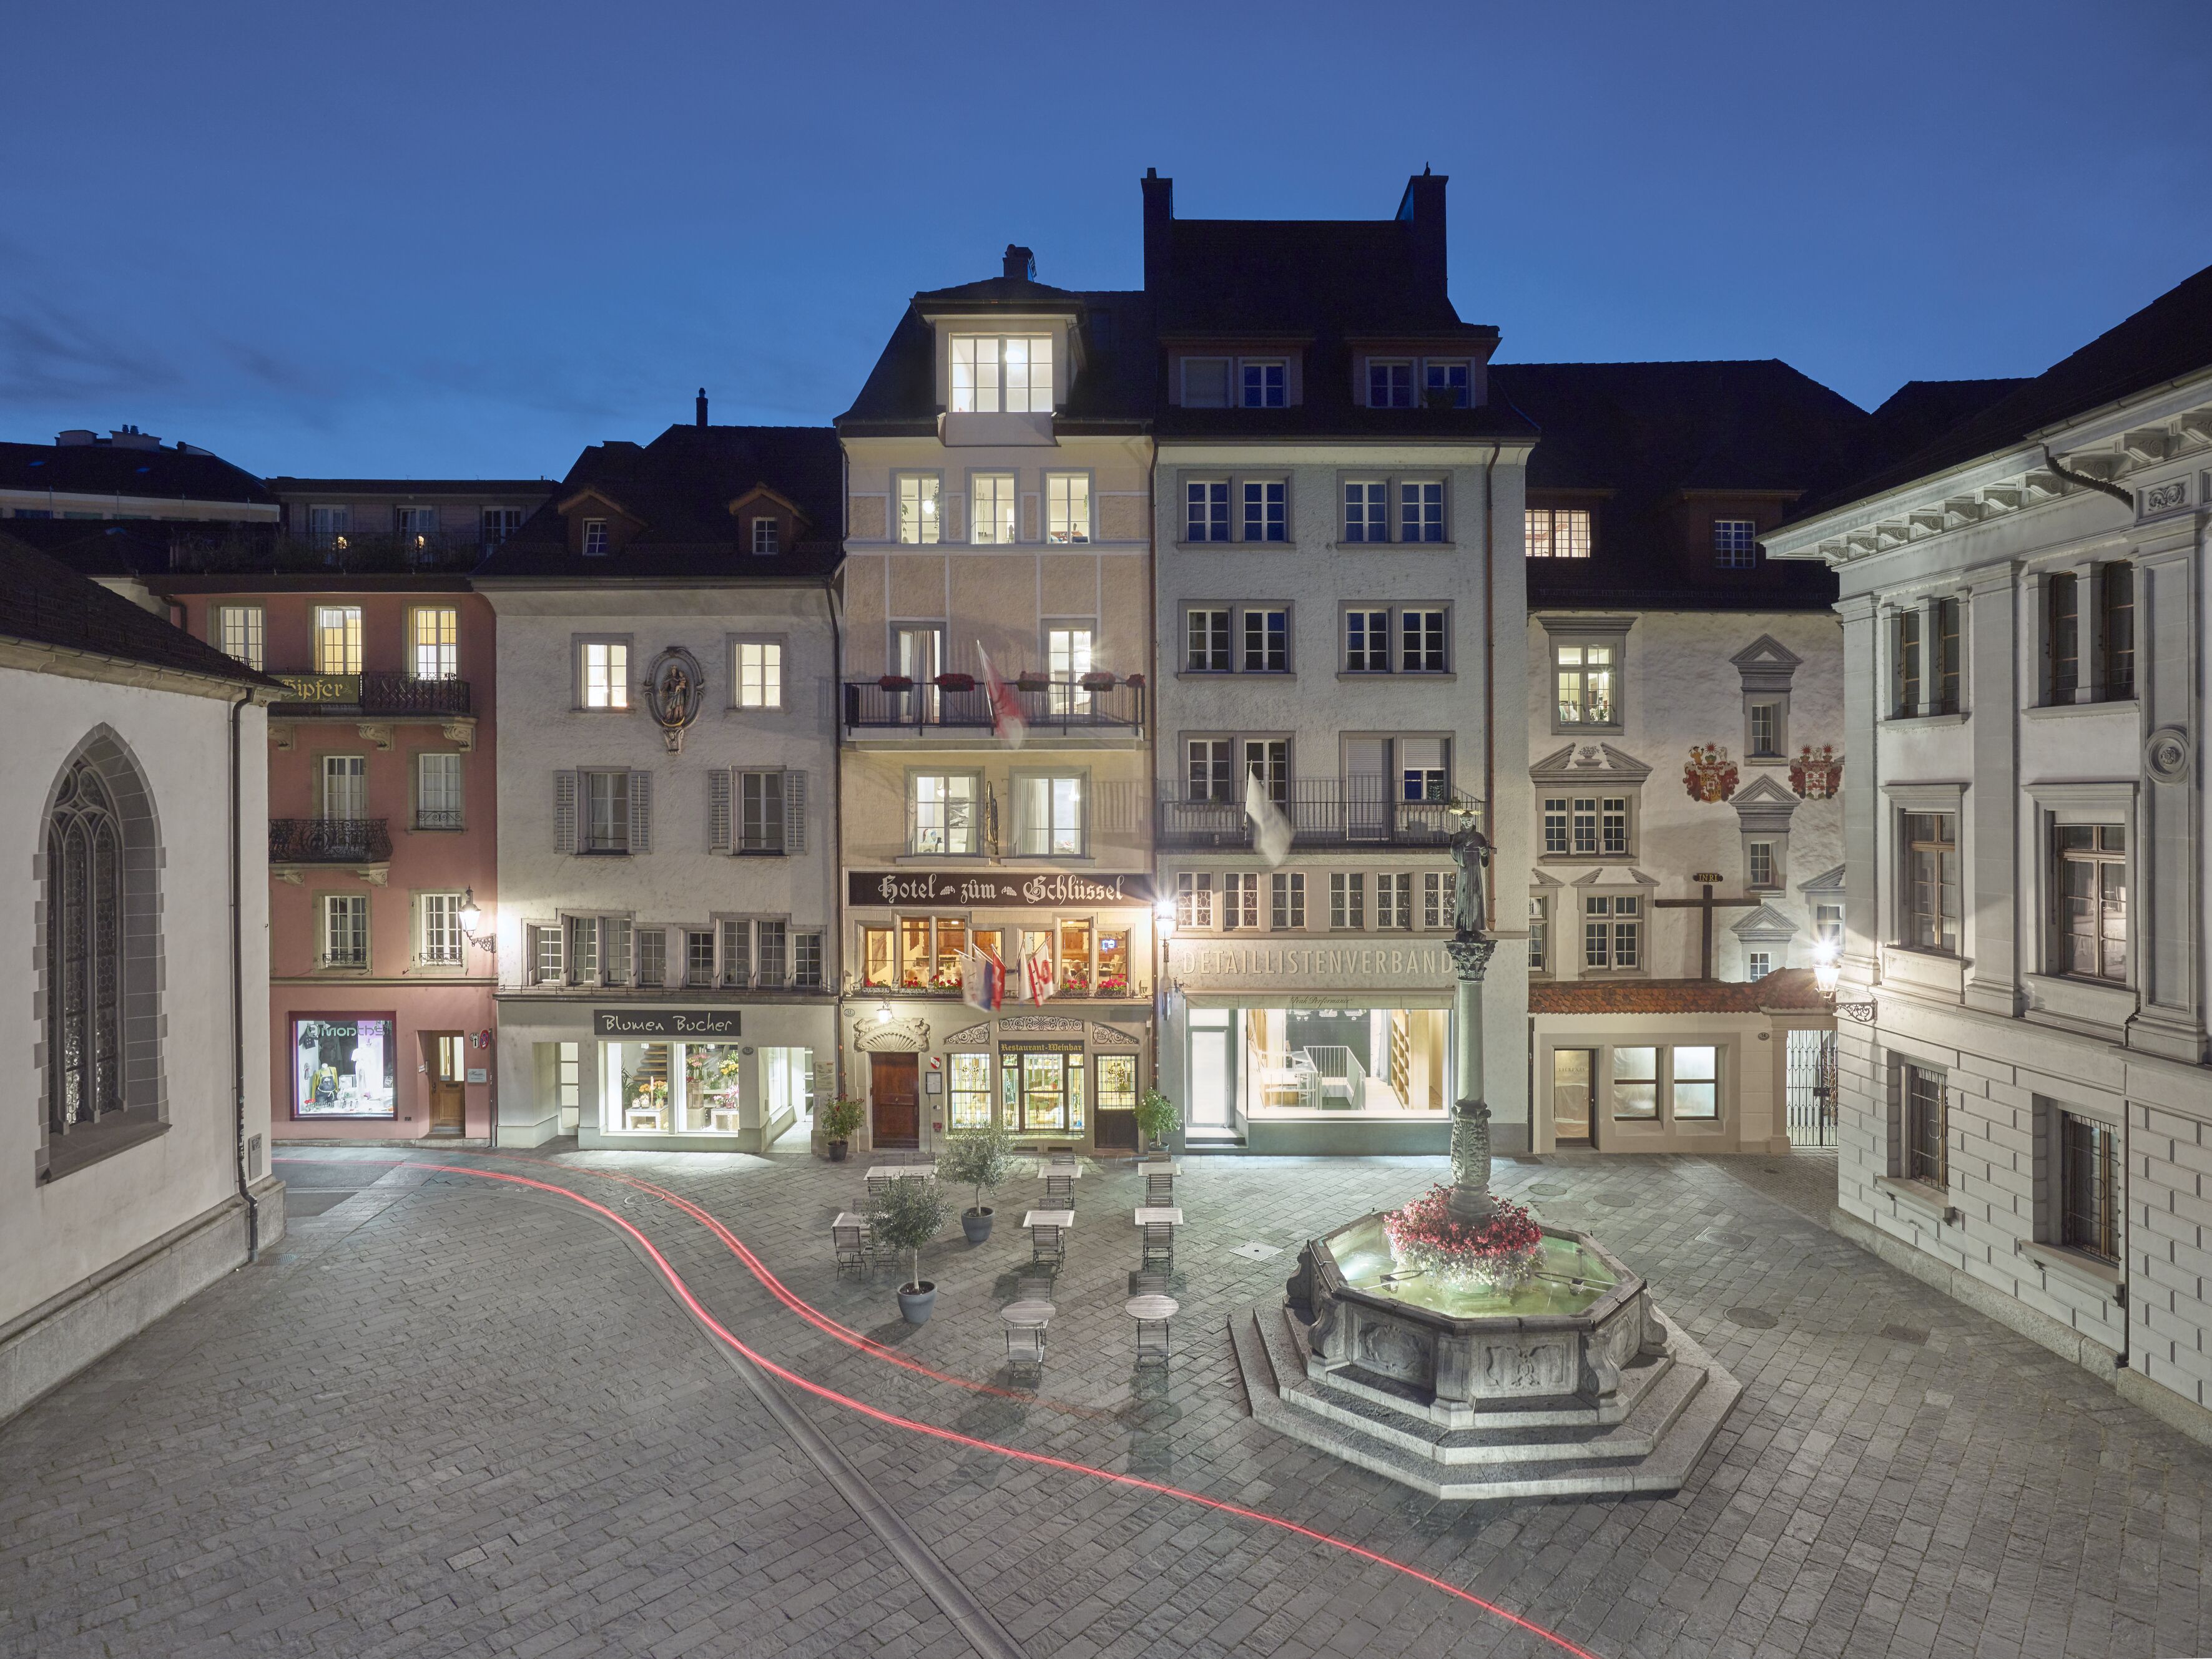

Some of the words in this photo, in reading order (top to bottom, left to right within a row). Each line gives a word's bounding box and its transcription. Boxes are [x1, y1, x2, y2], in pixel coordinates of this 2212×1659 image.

[878, 874, 936, 904] Hotel
[1023, 874, 1124, 905] Schlüssel
[1183, 950, 1453, 974] DETAILLISTENVERBAND
[1290, 996, 1309, 1004] Peak
[602, 1015, 664, 1030] Blumen
[672, 1012, 732, 1031] Bucher
[1000, 1043, 1082, 1052] Restaurant-Weinbar
